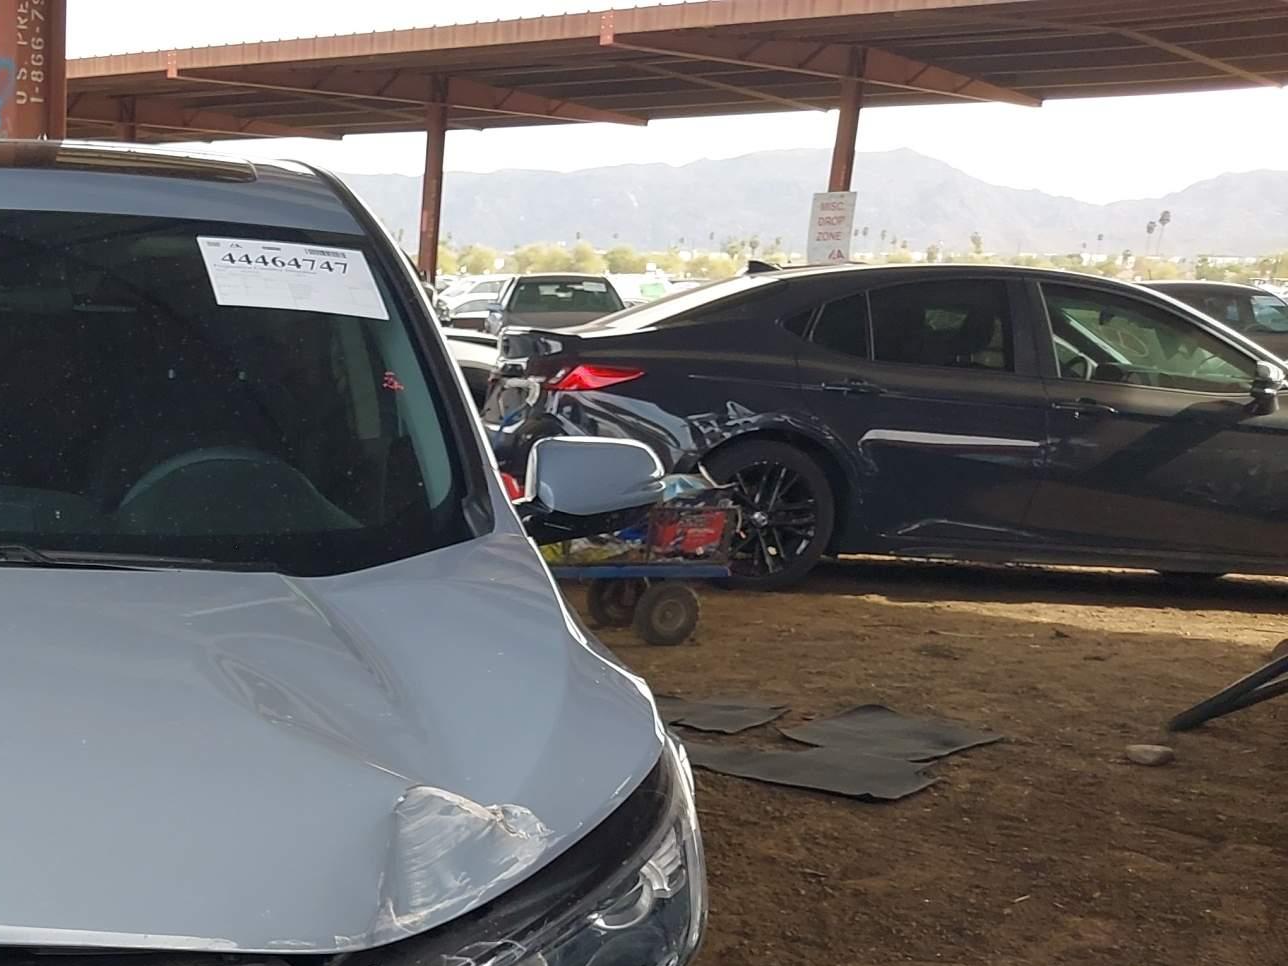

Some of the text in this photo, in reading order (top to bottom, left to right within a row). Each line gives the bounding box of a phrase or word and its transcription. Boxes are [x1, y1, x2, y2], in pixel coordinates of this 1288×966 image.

[817, 216, 846, 226] DROP
[816, 231, 843, 241] ZONE
[221, 252, 349, 275] 44464747
